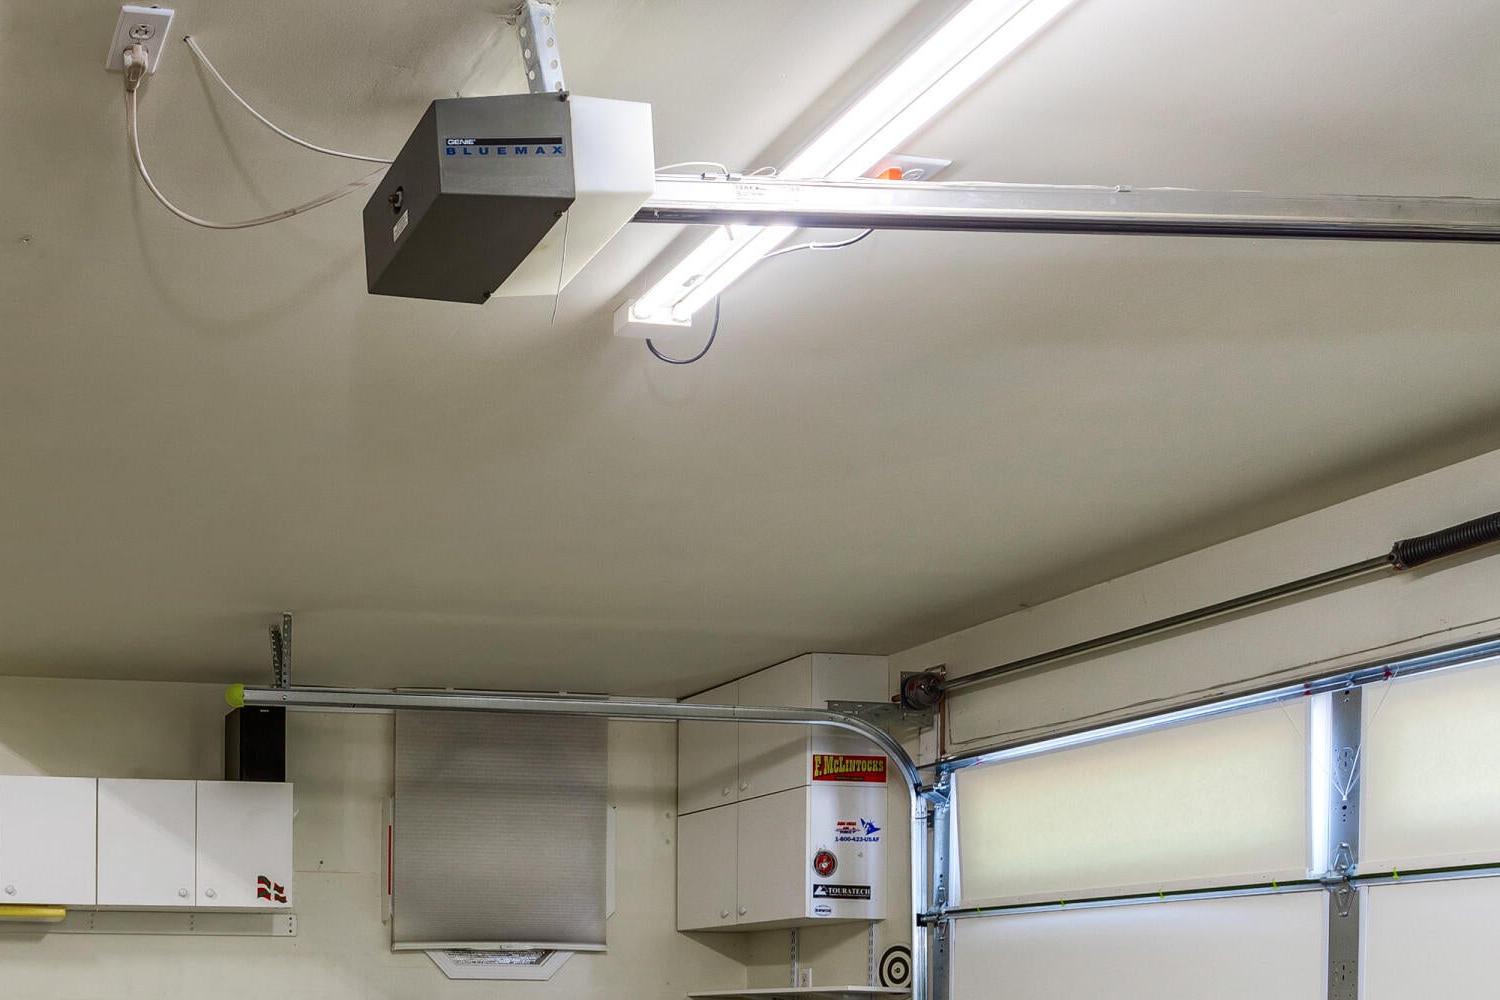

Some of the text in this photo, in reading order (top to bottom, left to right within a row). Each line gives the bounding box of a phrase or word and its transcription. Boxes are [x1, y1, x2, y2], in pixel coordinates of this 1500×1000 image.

[446, 146, 563, 156] BLUEMAX
[814, 755, 823, 777] F.
[828, 887, 870, 895] TOURATECH
